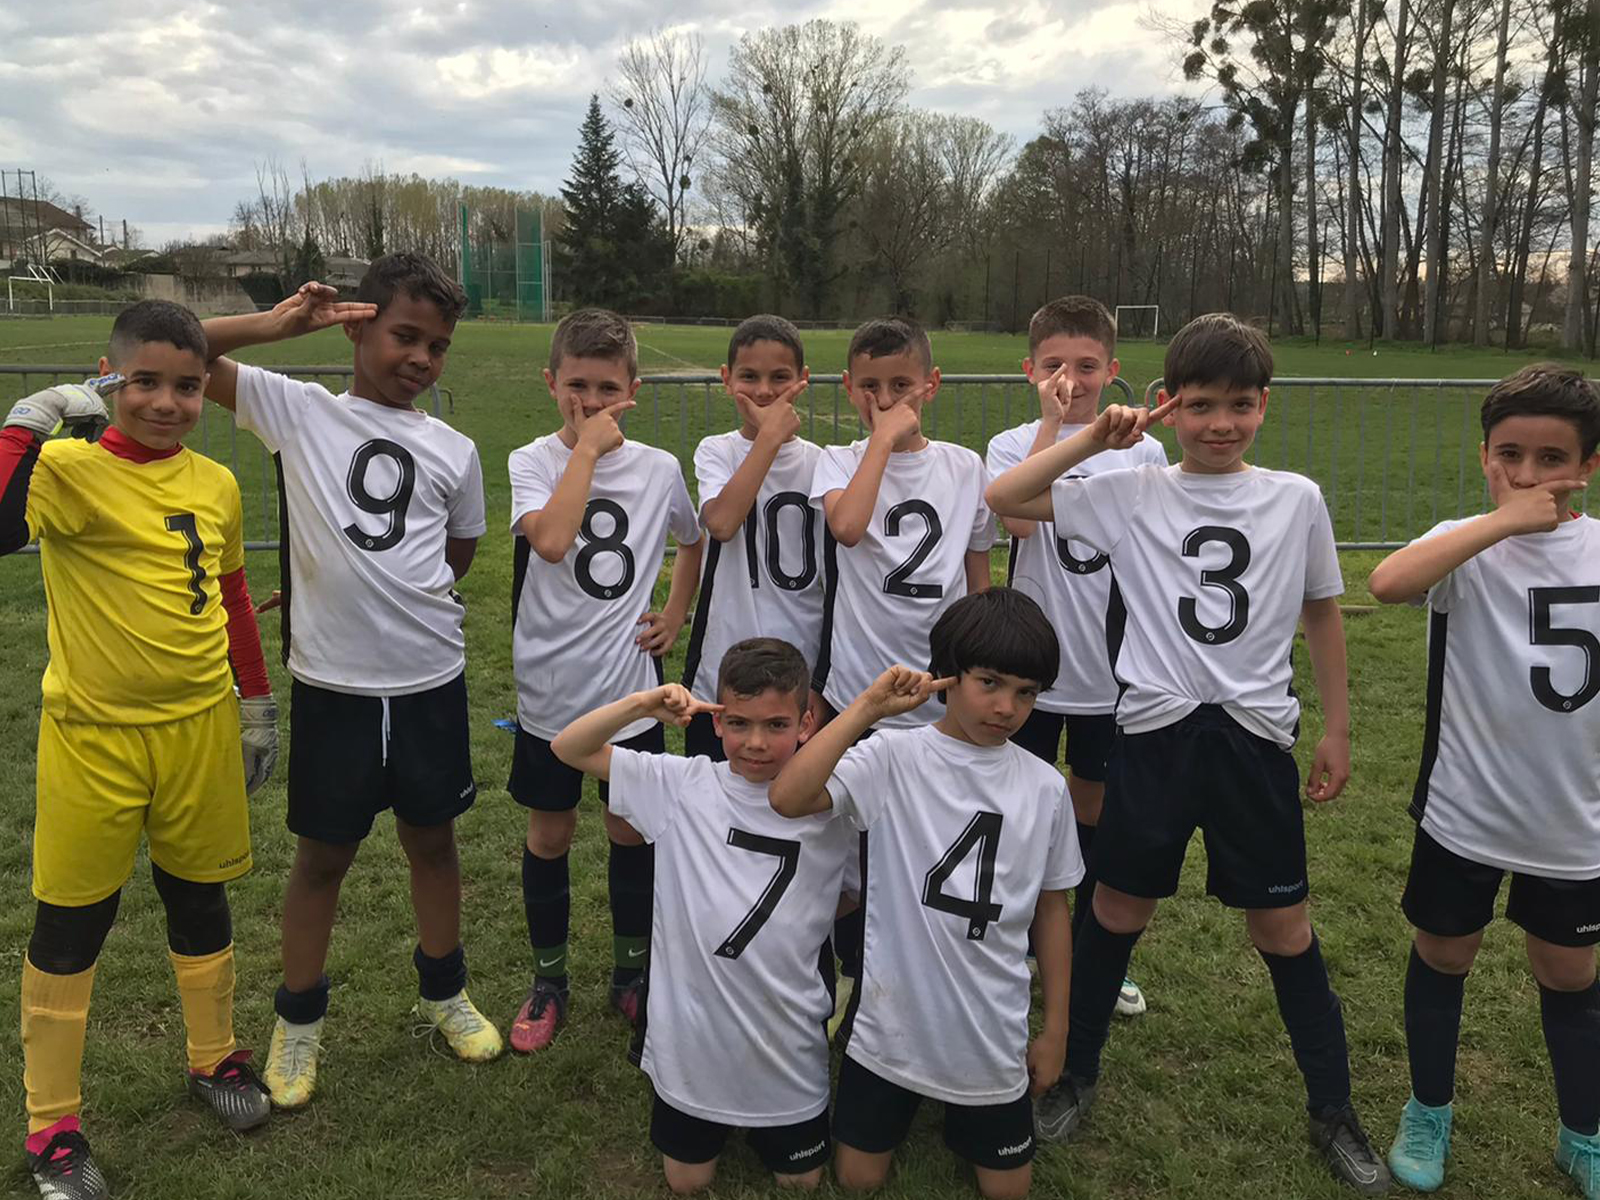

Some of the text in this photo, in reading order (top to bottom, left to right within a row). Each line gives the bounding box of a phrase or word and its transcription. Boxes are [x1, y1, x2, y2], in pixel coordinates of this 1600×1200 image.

[344, 438, 415, 552] 9
[574, 498, 635, 600] 8
[883, 499, 944, 599] 2
[164, 512, 208, 616] 1
[1177, 526, 1251, 646] 3
[1528, 585, 1600, 714] 5
[713, 827, 801, 960] 7
[921, 810, 1003, 941] 4
[789, 1140, 825, 1161] uhlsport
